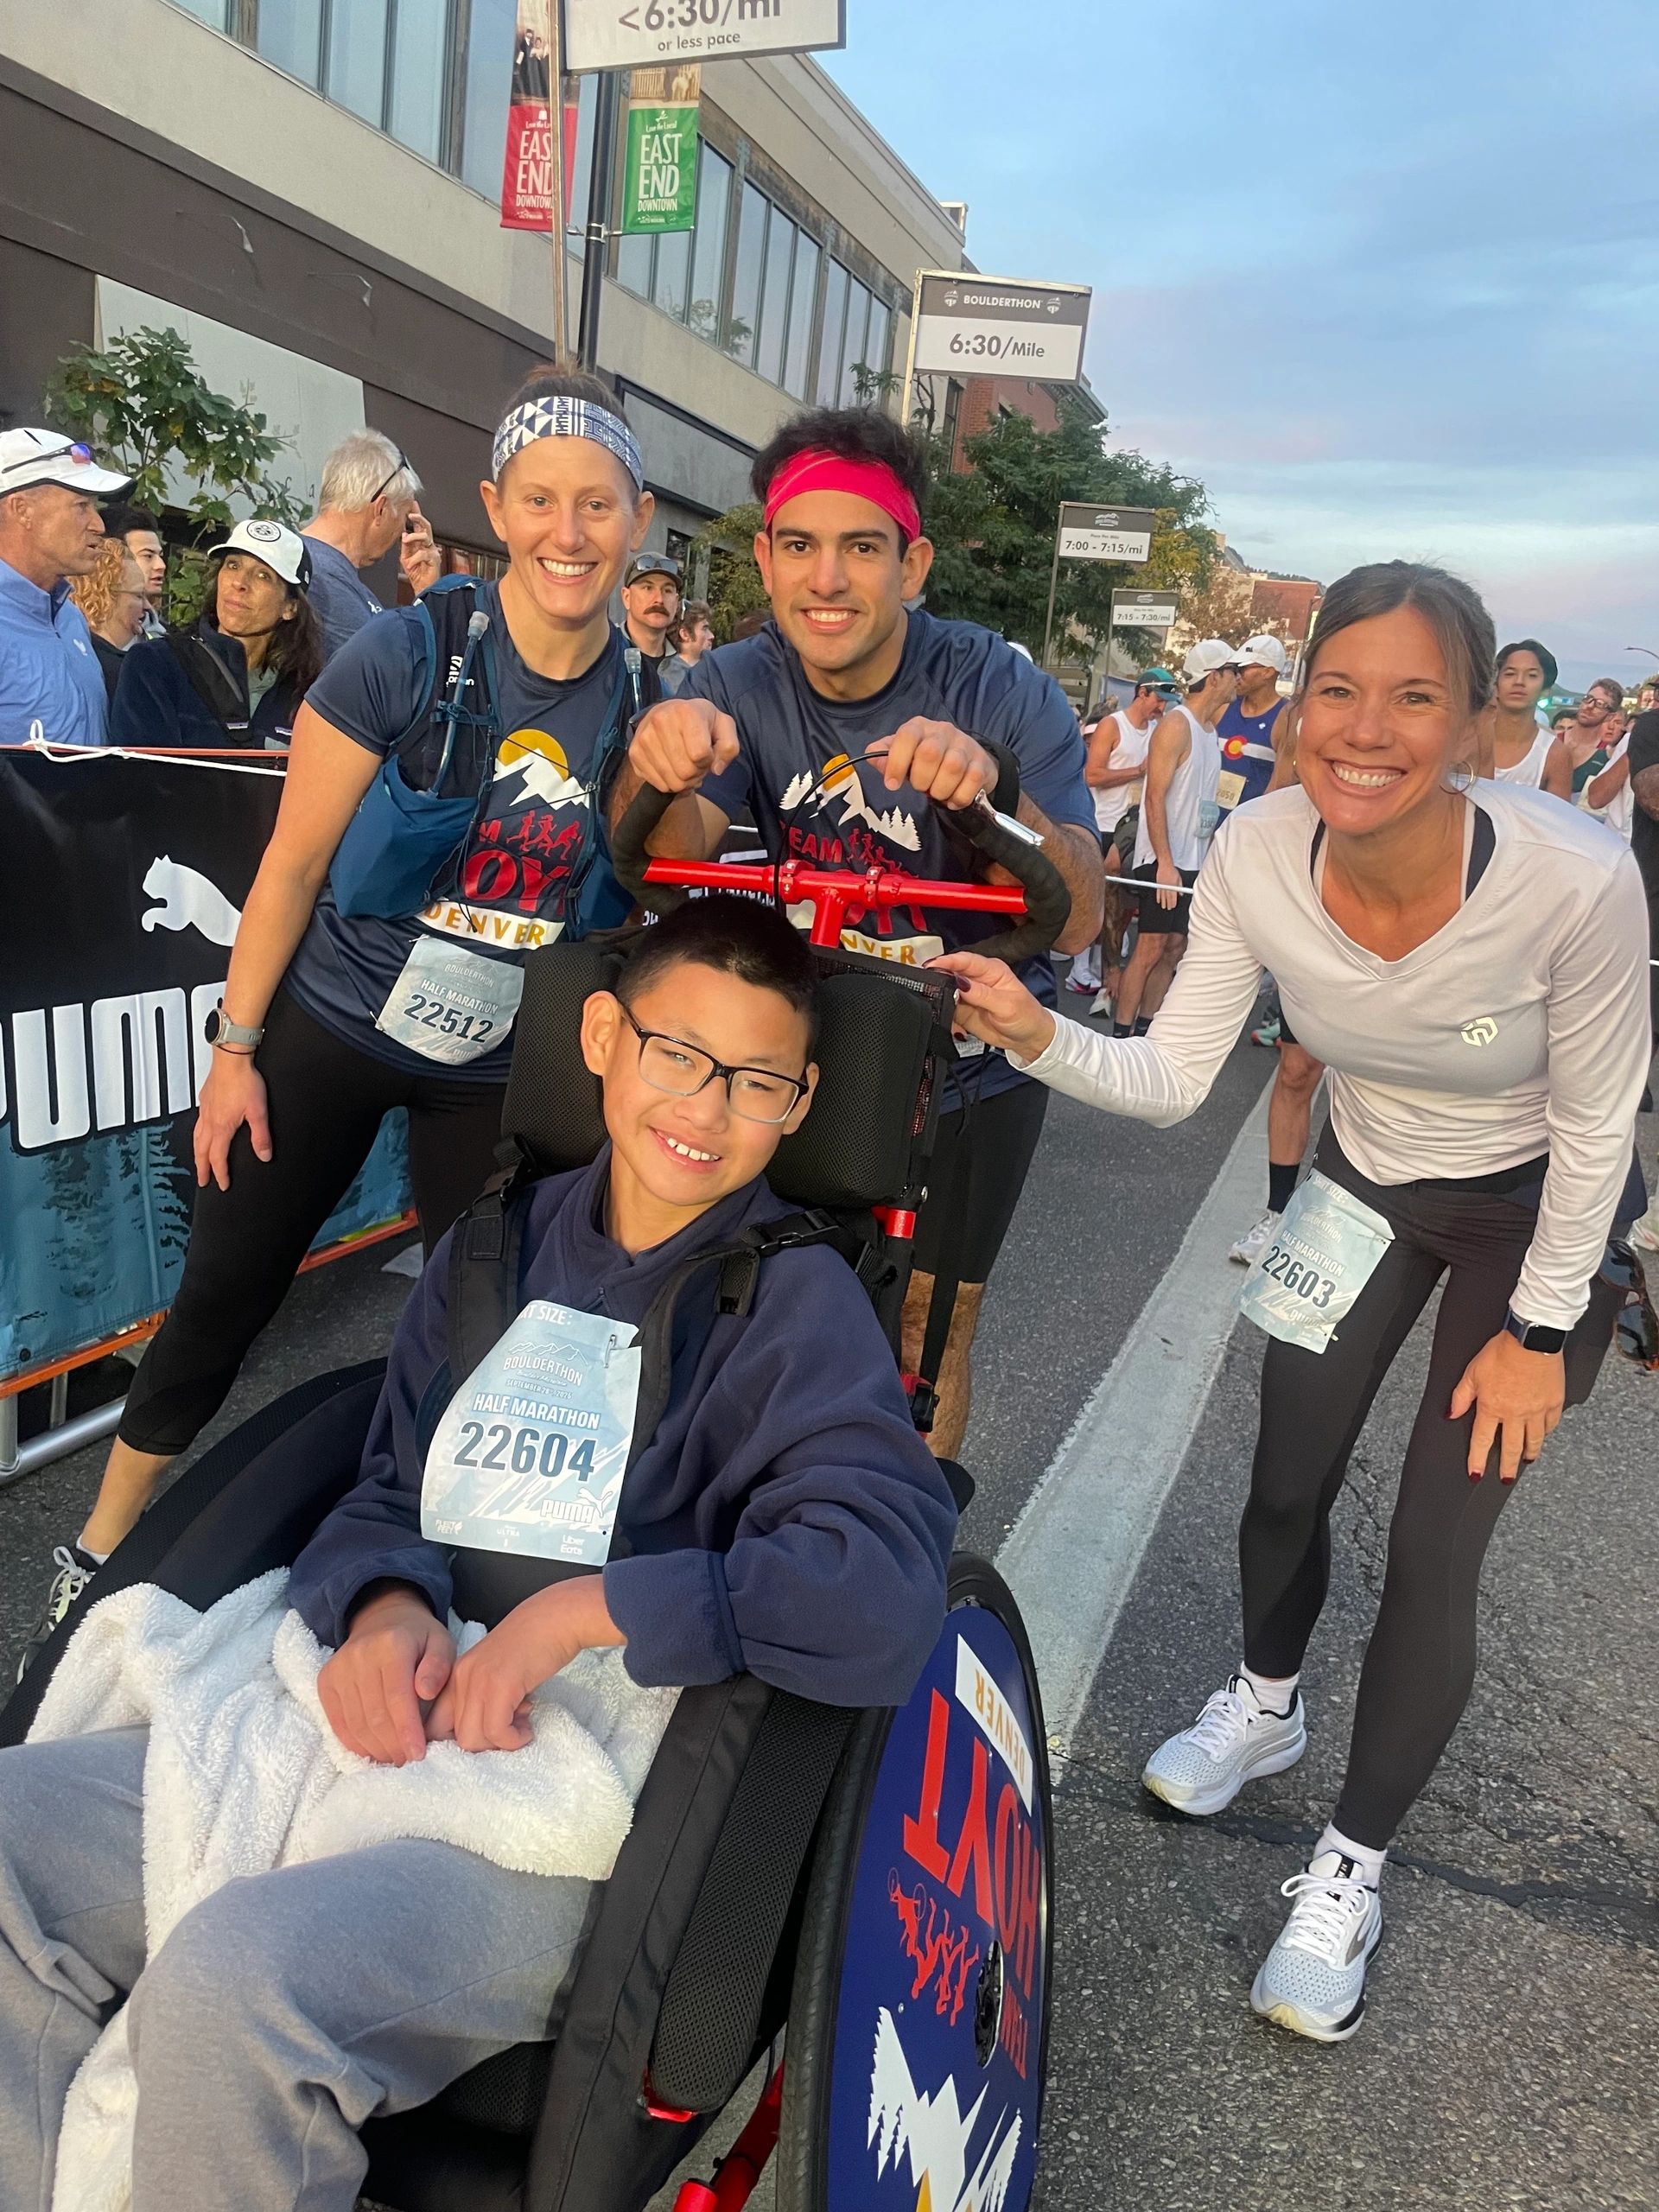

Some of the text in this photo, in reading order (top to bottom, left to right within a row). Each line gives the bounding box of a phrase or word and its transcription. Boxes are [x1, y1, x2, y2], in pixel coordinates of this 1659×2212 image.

[658, 33, 741, 52] or less pace
[519, 130, 551, 162] EAS
[640, 133, 683, 164] EAST
[639, 164, 680, 200] END
[516, 194, 554, 209] DOWNTOW
[637, 198, 678, 213] DOWNTOWN
[963, 295, 1041, 309] BOULDERTHON
[950, 333, 1045, 359] 6:30/Mile
[1065, 540, 1089, 551] 7:00
[1101, 543, 1143, 555] 7:15/mi
[423, 902, 545, 946] DENVER
[840, 933, 918, 965] NVER
[444, 963, 494, 988] BOULDERTHON
[421, 979, 446, 996] HALF
[445, 989, 499, 1015] MARATHON
[404, 994, 493, 1043] 22512
[1280, 1230, 1298, 1247] HALF
[1294, 1239, 1345, 1277] MARATHON
[1262, 1245, 1336, 1308] 22603
[537, 1305, 572, 1325] SIZE:
[503, 1355, 583, 1387] BOULDERTHON
[506, 1378, 542, 1393] SEPTEMBER
[474, 1394, 601, 1431] HALF MARATHON
[454, 1421, 596, 1482] 22604
[540, 1499, 594, 1523] PUMA
[561, 1545, 583, 1555] Eats
[975, 1669, 1026, 1786] DENVER
[904, 1687, 1041, 2001] HOYT
